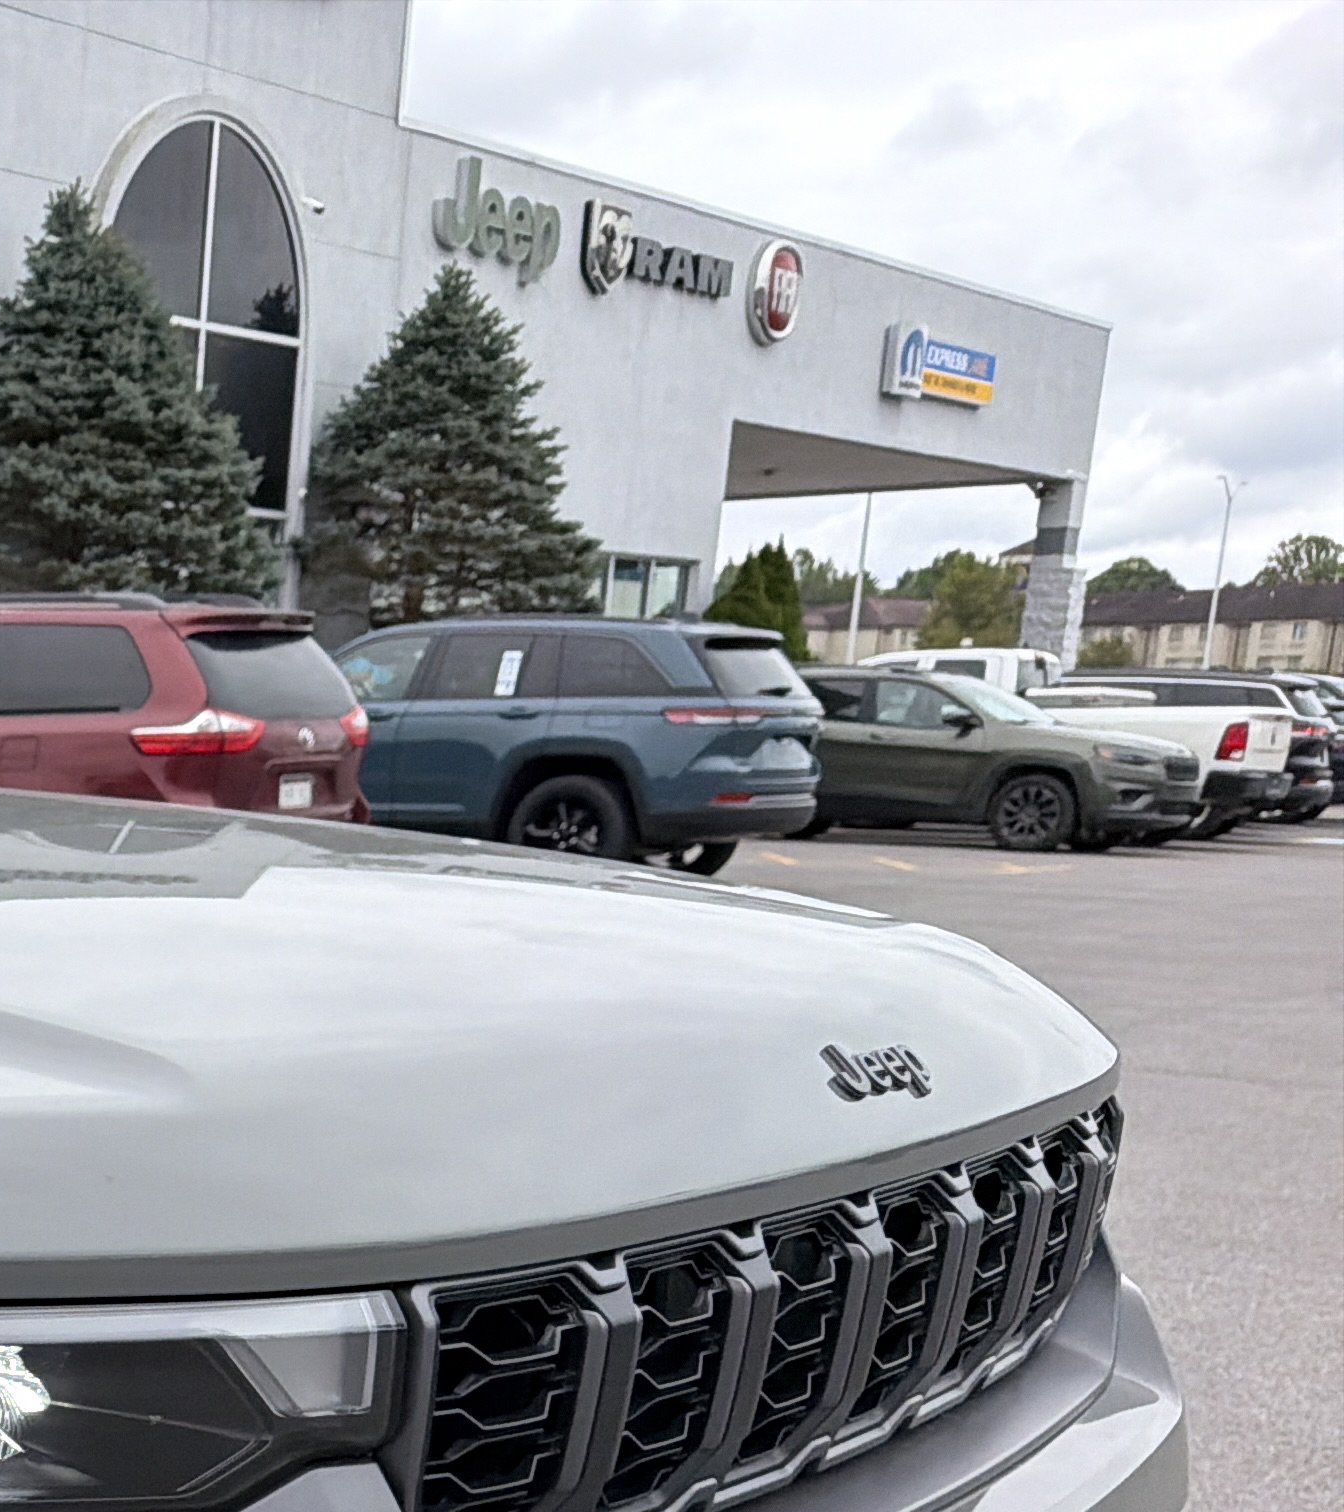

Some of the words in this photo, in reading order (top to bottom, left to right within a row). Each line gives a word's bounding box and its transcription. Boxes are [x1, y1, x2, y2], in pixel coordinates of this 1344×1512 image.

[432, 156, 560, 287] Jeep
[628, 236, 734, 300] RAM
[926, 345, 970, 373] EXPRESS
[819, 1044, 932, 1102] Jeep
